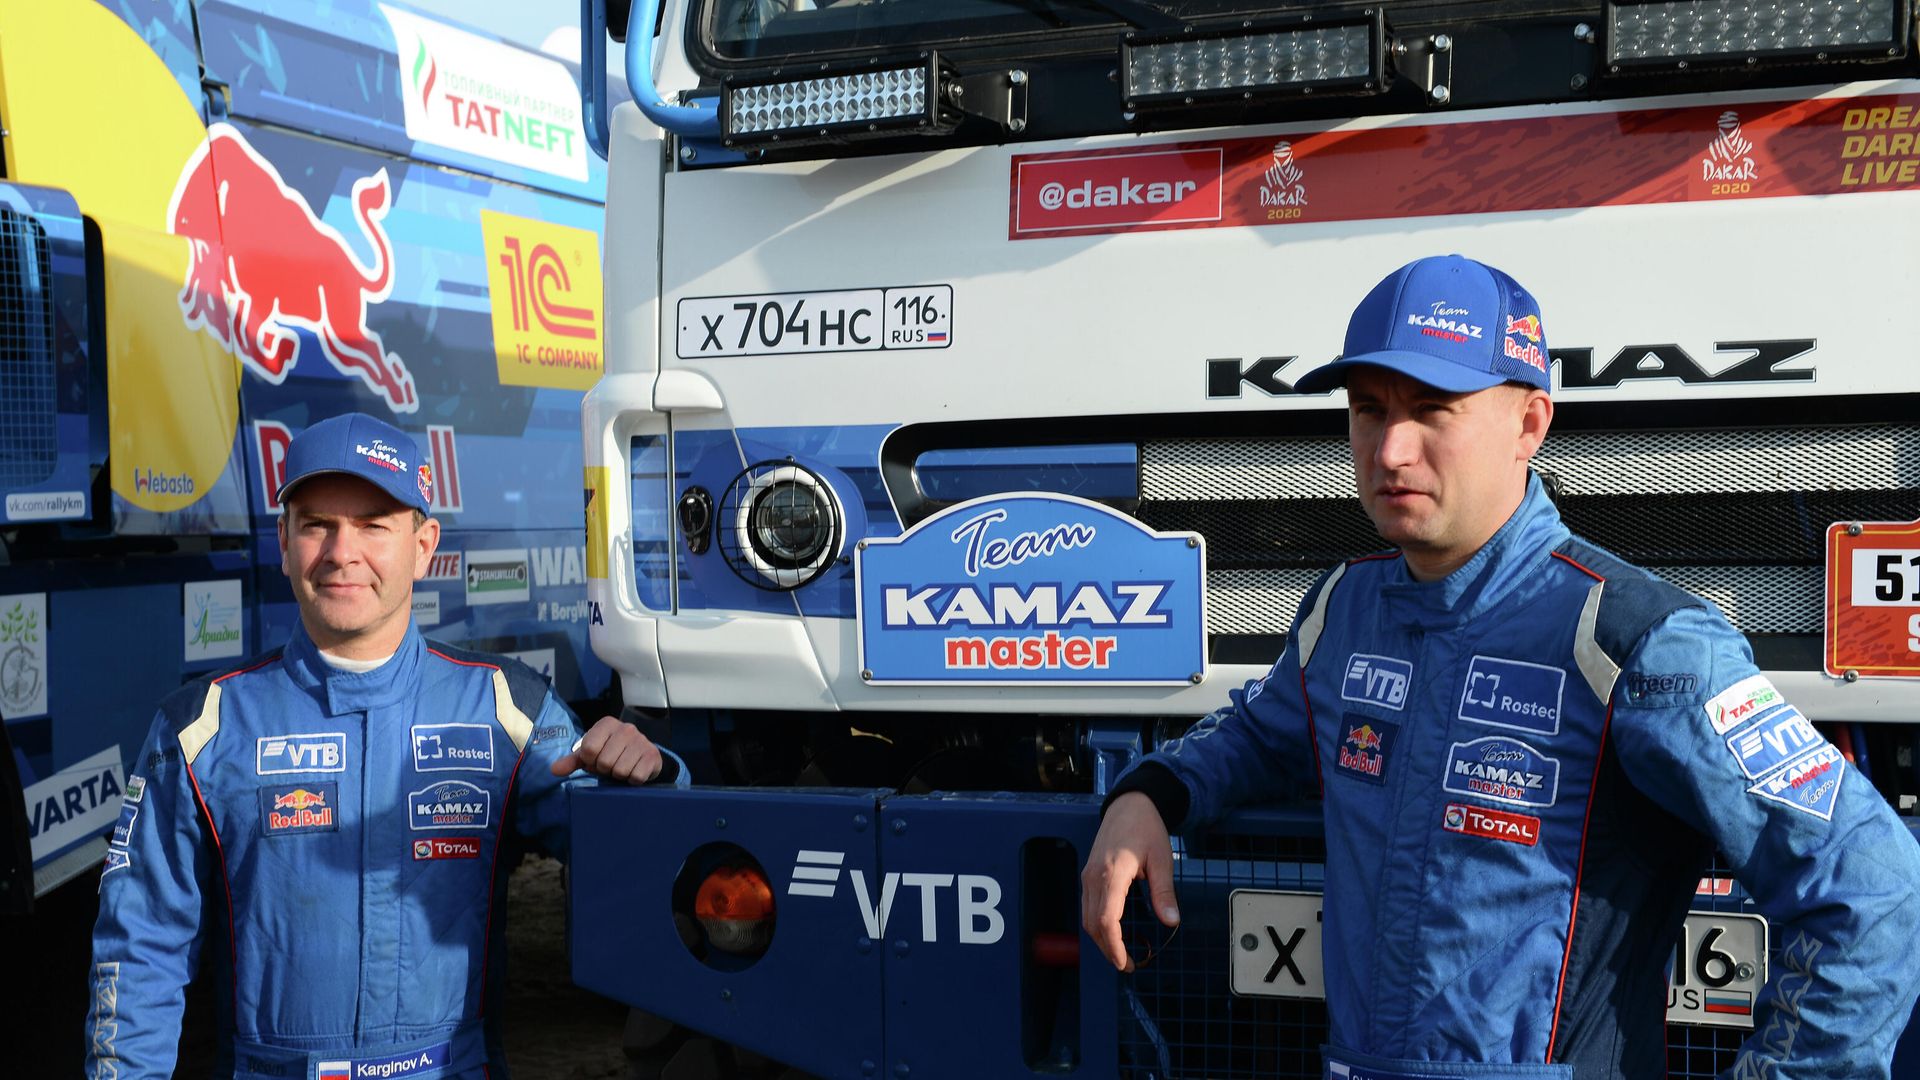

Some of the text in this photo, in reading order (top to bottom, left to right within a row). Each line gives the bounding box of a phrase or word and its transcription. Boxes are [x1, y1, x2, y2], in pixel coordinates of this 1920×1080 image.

[445, 93, 575, 158] TATNEFT
[1702, 157, 1758, 182] DAKAR
[1841, 160, 1920, 185] LIVE
[1038, 177, 1196, 211] @dakar
[1259, 184, 1308, 207] DAKAR
[1712, 182, 1750, 195] 2020
[1267, 208, 1301, 220] 2020
[894, 296, 938, 326] 116
[1431, 301, 1469, 316] Team
[892, 330, 924, 343] RUS
[1408, 314, 1483, 339] KAMAZ
[1421, 327, 1468, 343] master
[537, 346, 599, 371] COMPANY
[1504, 336, 1531, 364] Red
[356, 445, 407, 472] KAMAZ
[134, 468, 194, 495] Webasto
[8, 497, 83, 514] vk.com/rallykm
[953, 510, 1094, 575] Team
[883, 583, 1170, 628] KAMAZ
[946, 632, 1116, 667] master
[1366, 667, 1407, 704] VTB
[1501, 696, 1557, 720] Rostec
[1763, 720, 1815, 757] VTB
[287, 742, 340, 767] VTB
[448, 748, 491, 760] Rostec
[1339, 746, 1382, 776] Red Bull
[1480, 743, 1525, 763] Team
[1454, 760, 1544, 789] KAMAZ
[1768, 747, 1840, 795] KAMAZ
[1468, 778, 1526, 800] master
[28, 769, 122, 839] VARTA
[417, 803, 483, 815] KAMAZ
[269, 807, 333, 830] Red Bull
[432, 814, 475, 824] master
[1470, 812, 1533, 838] TOTAL
[435, 842, 478, 854] TOTAL
[850, 869, 1005, 945] VTB
[419, 1053, 433, 1067] A.
